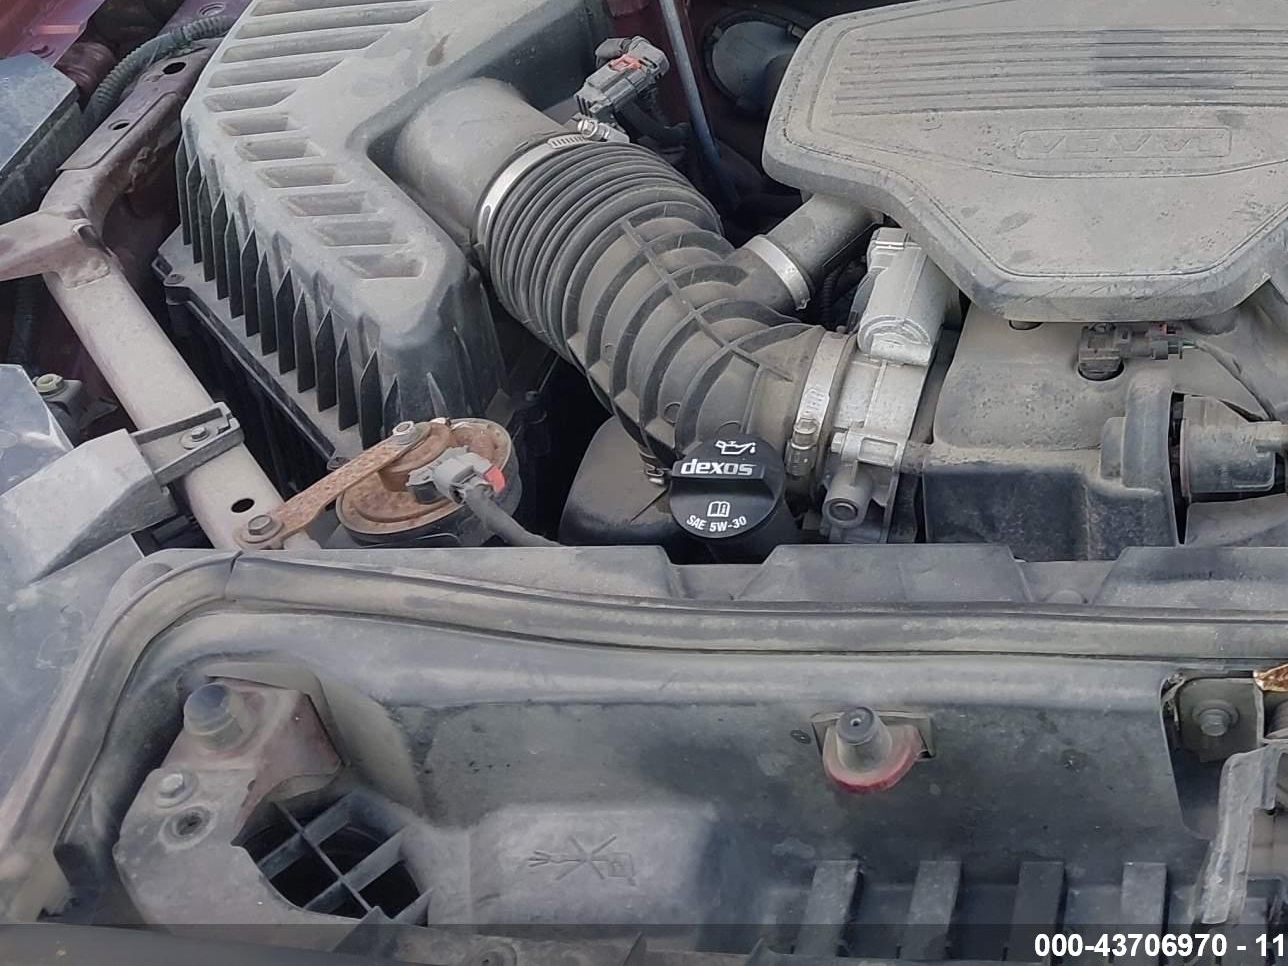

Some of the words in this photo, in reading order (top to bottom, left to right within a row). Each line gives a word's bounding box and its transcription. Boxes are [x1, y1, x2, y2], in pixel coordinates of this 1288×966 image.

[680, 458, 757, 476] dexos
[686, 515, 707, 531] SAE
[709, 515, 747, 532] 5W-30
